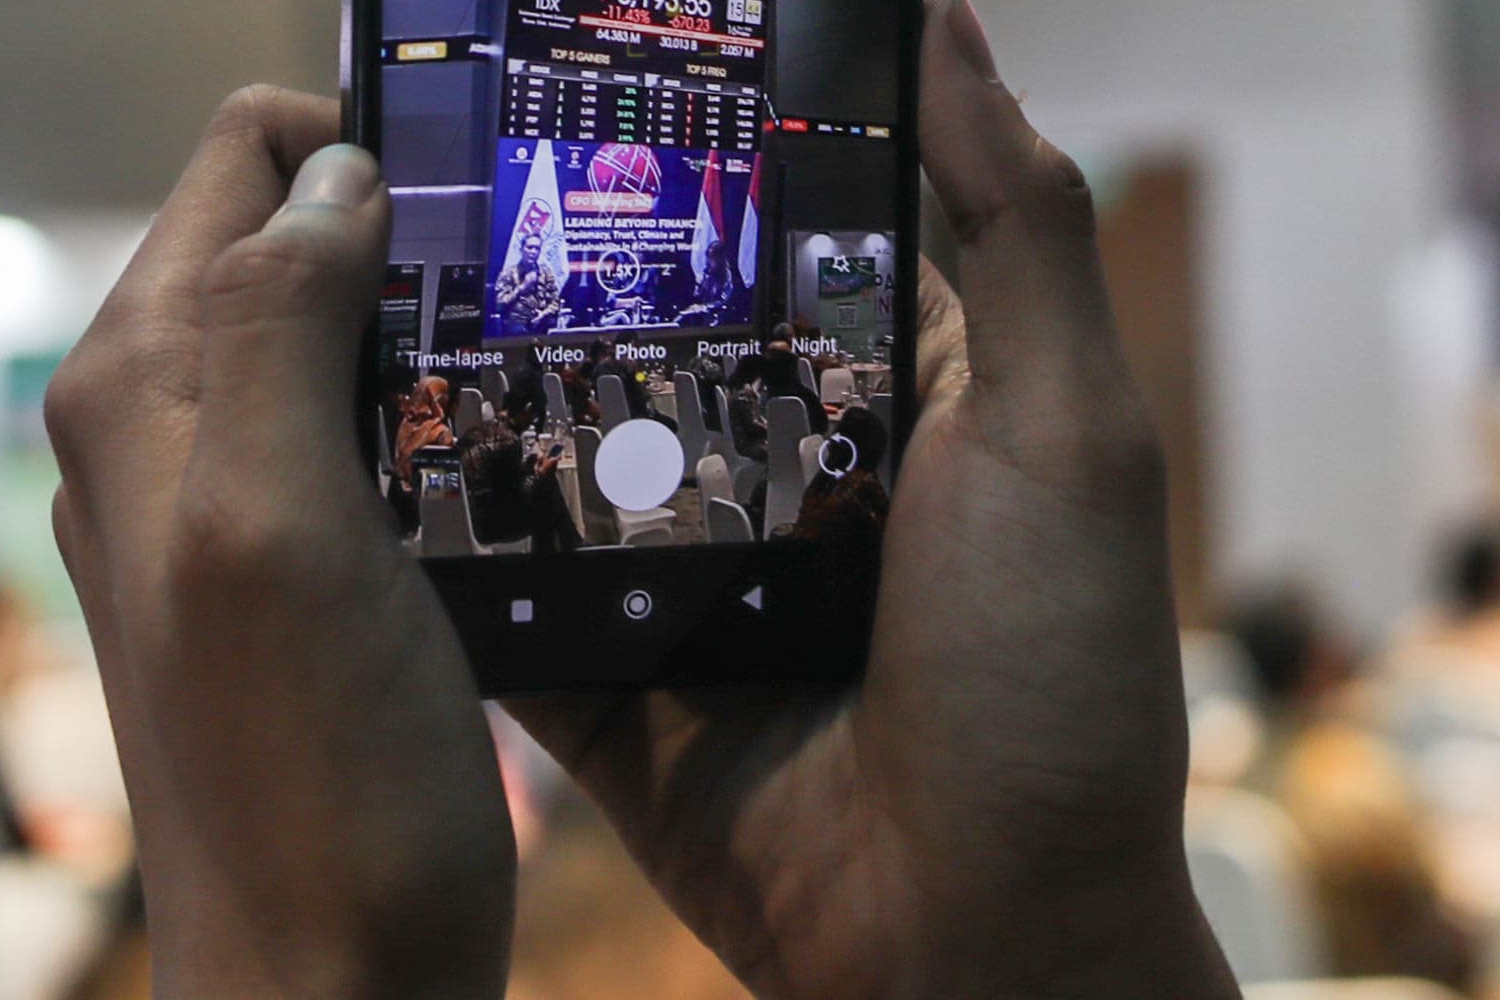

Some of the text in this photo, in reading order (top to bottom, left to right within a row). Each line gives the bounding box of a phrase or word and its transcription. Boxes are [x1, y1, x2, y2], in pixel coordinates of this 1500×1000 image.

[602, 5, 651, 25] -11.43%
[668, 16, 711, 32] -670.23
[629, 33, 641, 44] M
[551, 48, 567, 61] TOP
[576, 52, 611, 65] GAINERS
[744, 47, 755, 58] M
[686, 64, 700, 74] TOP
[565, 218, 612, 228] LEADING
[614, 218, 656, 228] BEYOND
[407, 336, 838, 369] Time-lapse Video Photo Portrait Night
